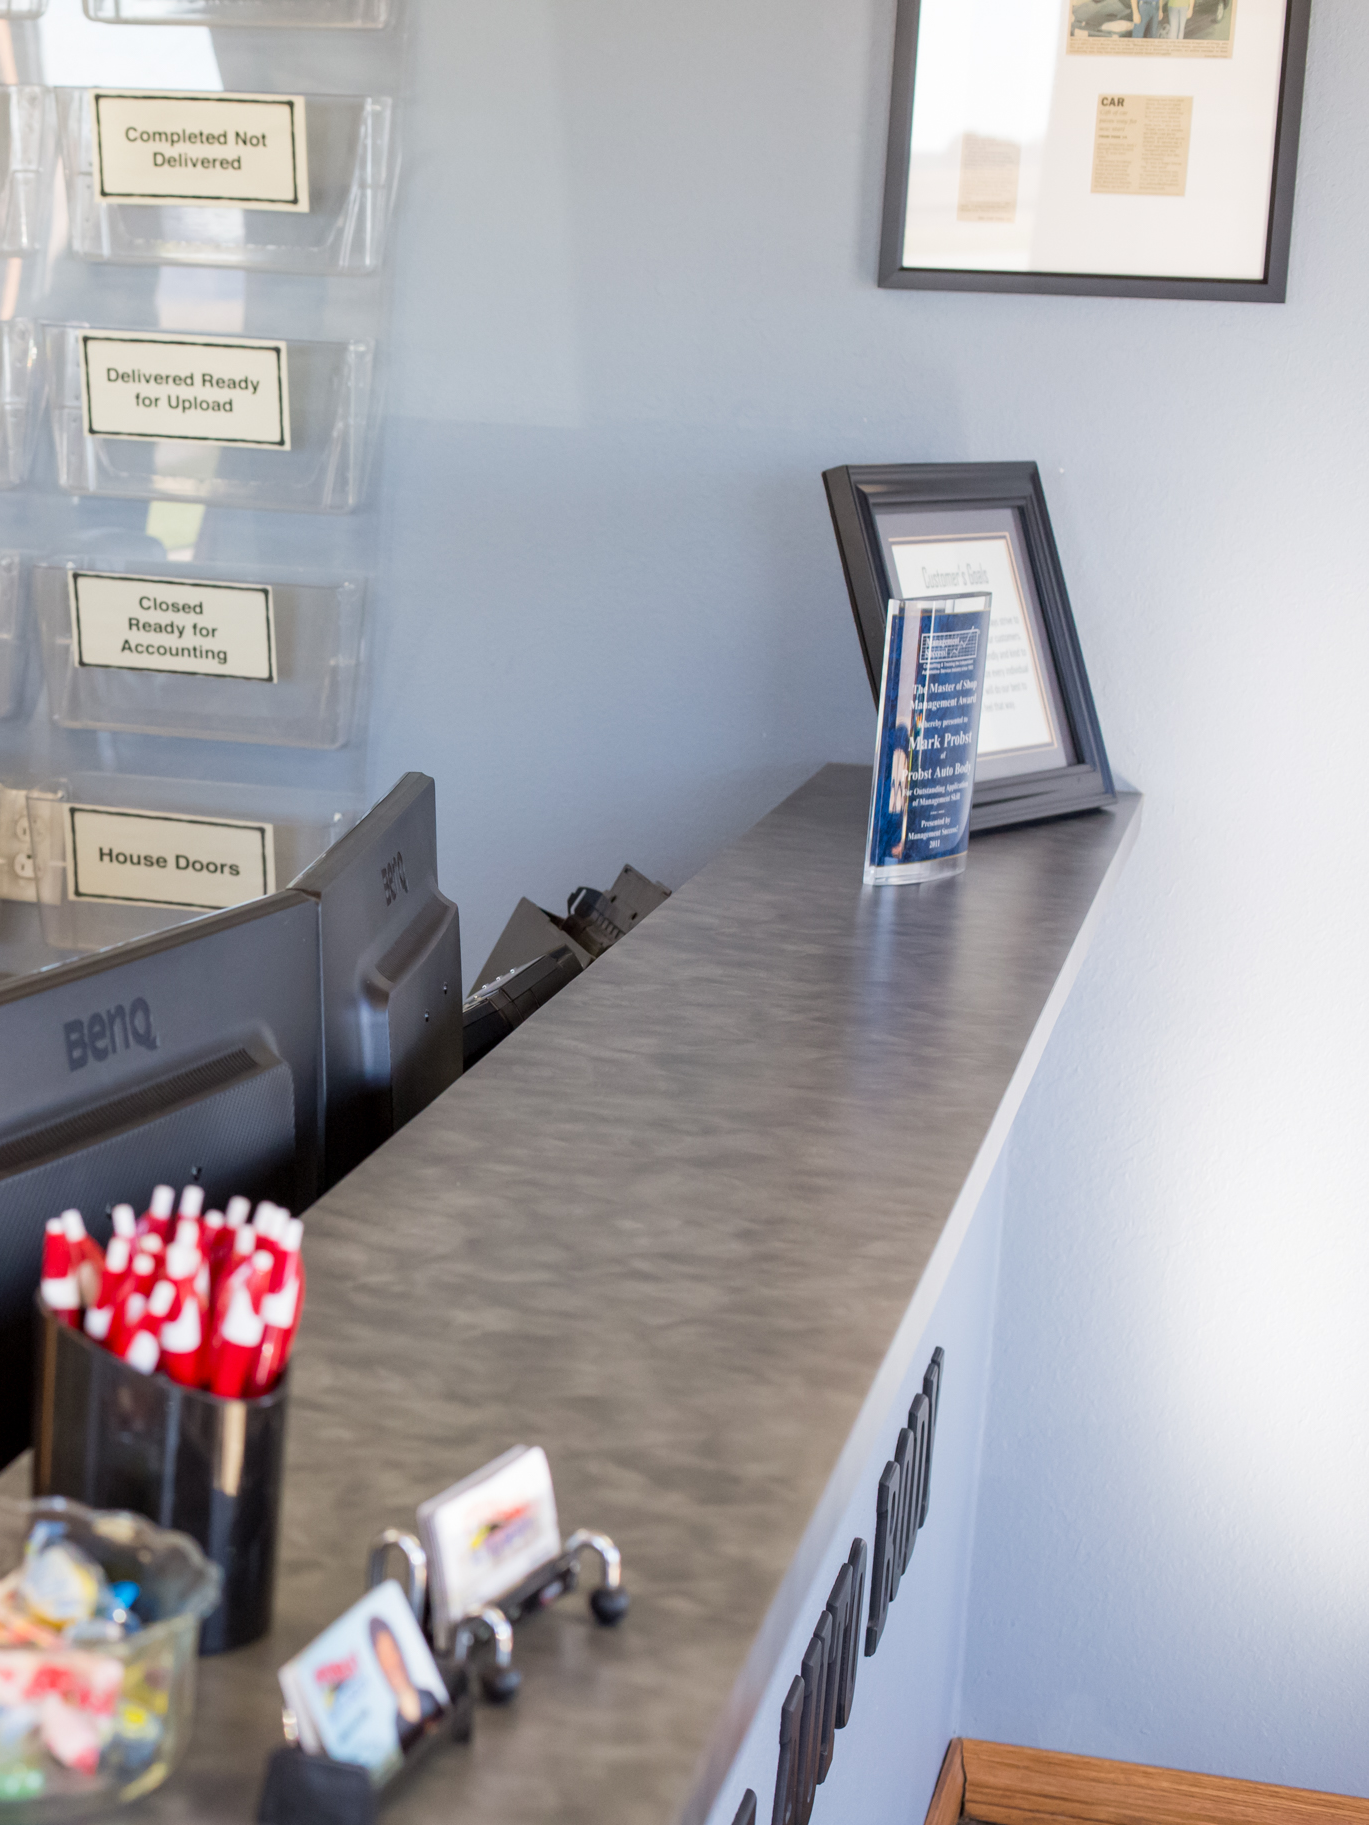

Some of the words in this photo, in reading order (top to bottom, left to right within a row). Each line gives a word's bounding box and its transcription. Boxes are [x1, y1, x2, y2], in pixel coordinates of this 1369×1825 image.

[1101, 97, 1125, 107] CAR
[125, 126, 228, 147] Completed
[234, 130, 268, 148] Not
[153, 151, 242, 171] Delivered
[106, 367, 195, 387] Delivered
[201, 372, 260, 395] Ready
[135, 392, 161, 408] for
[167, 394, 234, 414] Upload
[139, 596, 204, 615] Closed
[128, 617, 186, 638] Ready
[192, 622, 218, 639] for
[121, 639, 228, 665] Accounting
[929, 683, 955, 693] Master
[956, 680, 963, 690] of
[908, 734, 941, 751] Mark
[944, 730, 972, 748] Probst
[934, 766, 954, 778] Auto
[98, 846, 168, 869] House
[175, 853, 241, 877] Doors
[63, 996, 158, 1072] BenQ
